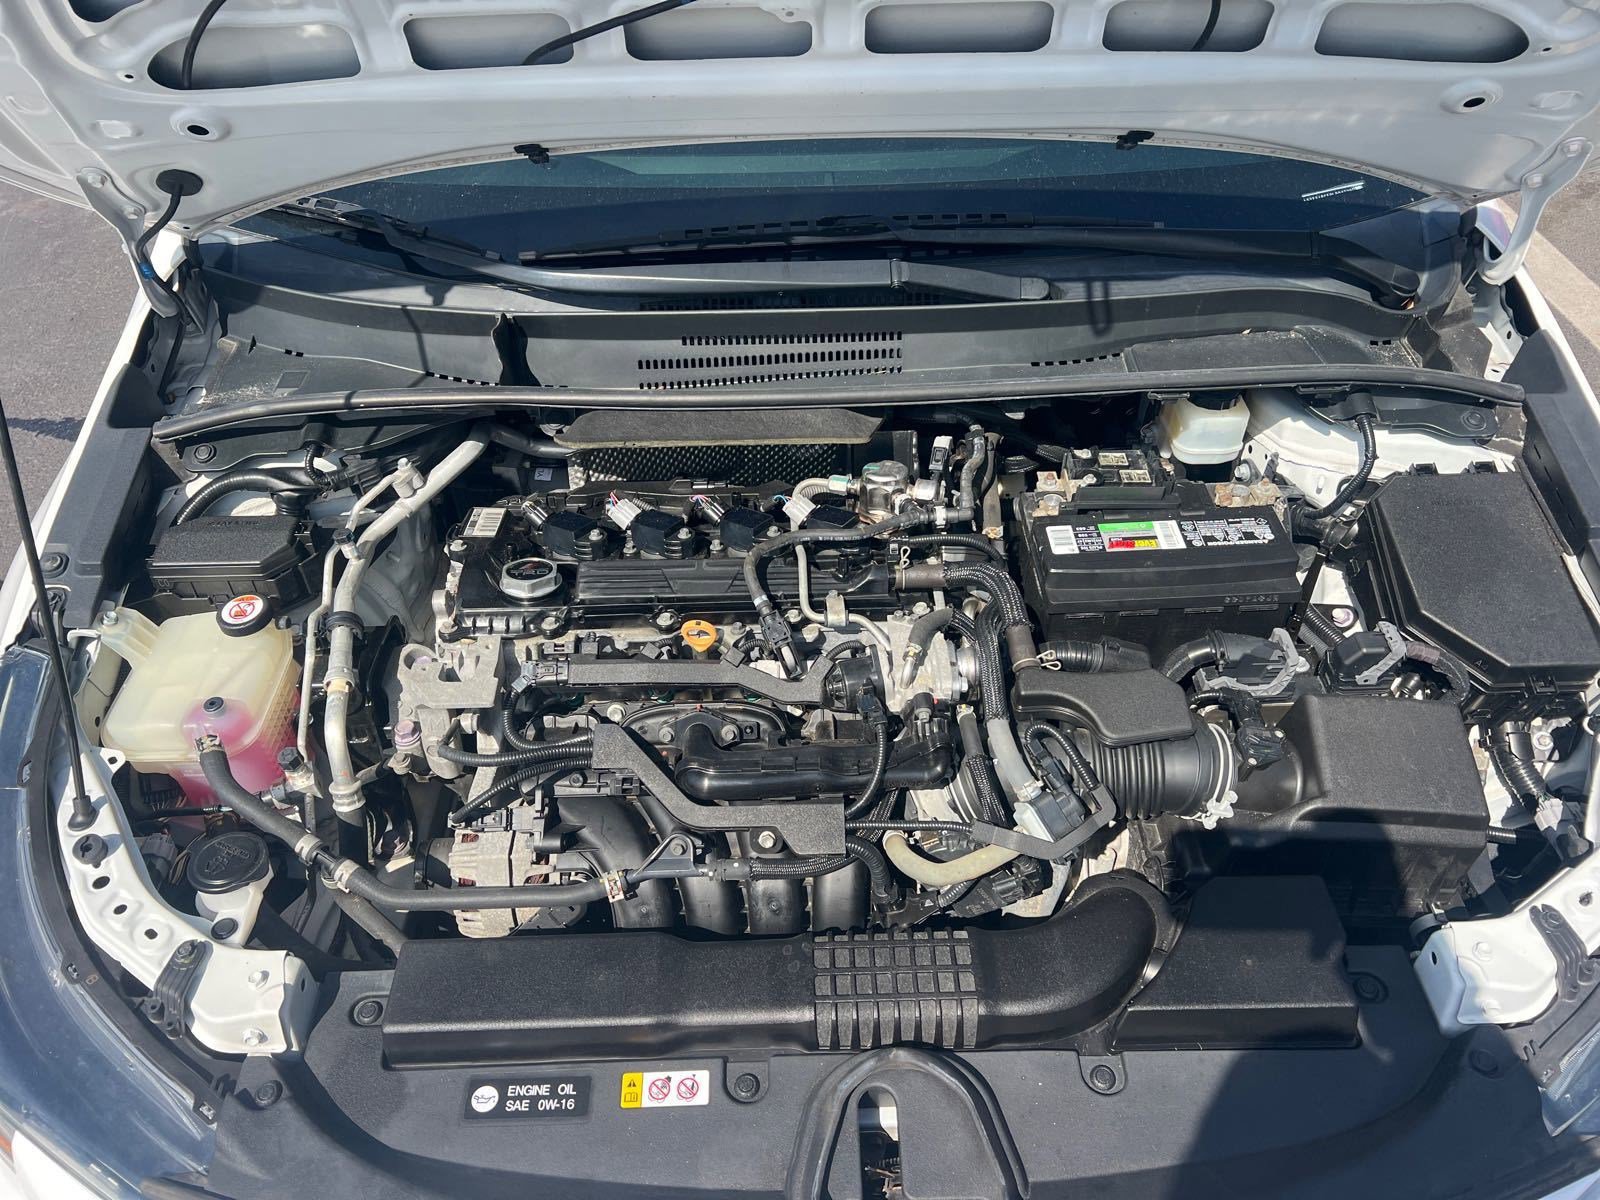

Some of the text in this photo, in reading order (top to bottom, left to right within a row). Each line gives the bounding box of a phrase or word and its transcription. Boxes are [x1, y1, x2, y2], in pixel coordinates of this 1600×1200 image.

[510, 568, 549, 576] TRD
[507, 1084, 577, 1097] ENGINE OIL
[505, 1098, 575, 1111] SAE 0W-16
